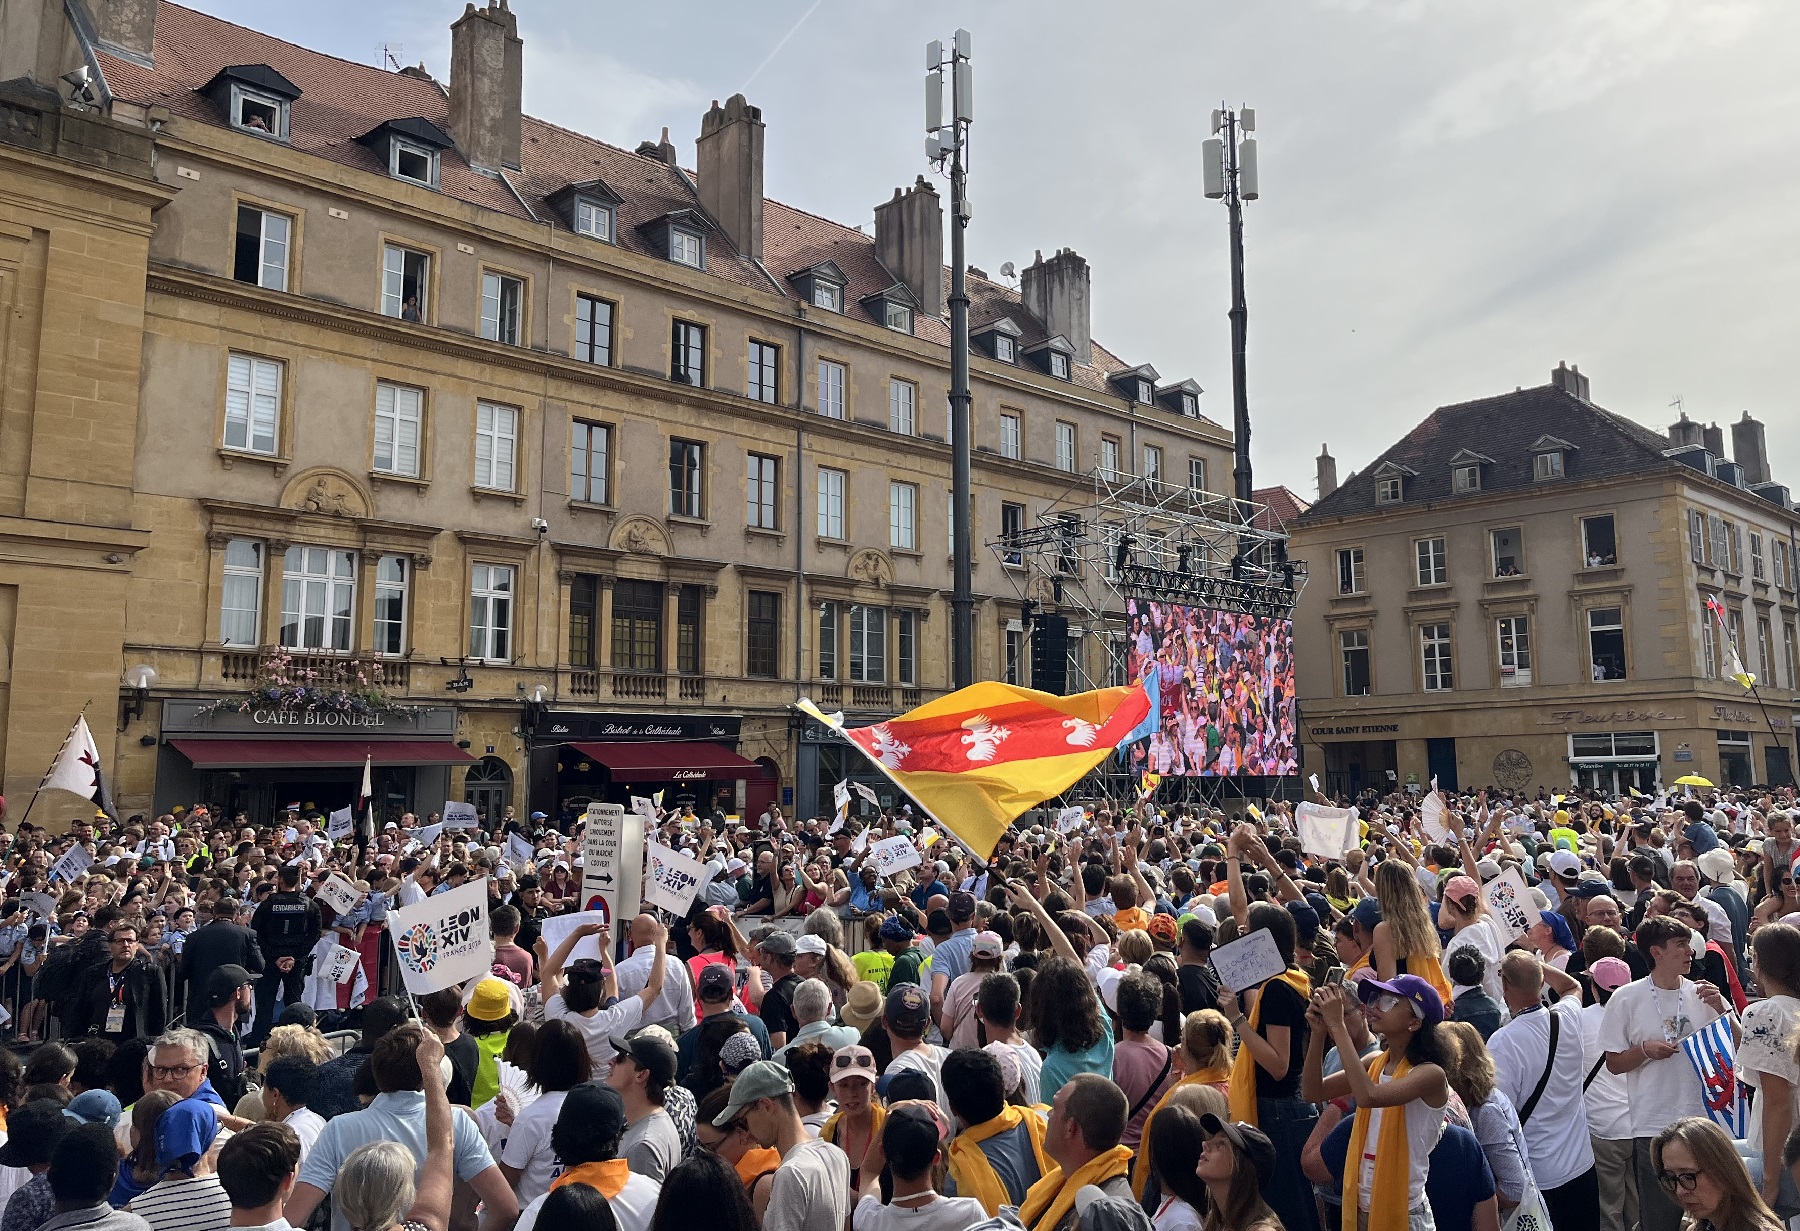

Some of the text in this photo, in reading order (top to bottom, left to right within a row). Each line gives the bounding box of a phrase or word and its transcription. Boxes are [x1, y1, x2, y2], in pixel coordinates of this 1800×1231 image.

[303, 711, 385, 726] BLONDEL
[601, 723, 633, 735] Bistrot
[644, 724, 682, 736] Cathédrale
[1312, 724, 1399, 735] COUR SAINT ETIENNE
[672, 770, 707, 779] La Cathédrale
[588, 808, 620, 817] STATIONNEMENT
[589, 828, 616, 837] UNIQUEMENT
[598, 839, 605, 847] LA
[891, 842, 910, 852] LEON
[588, 849, 596, 857] DU
[894, 848, 907, 857] XIV
[590, 859, 610, 868] COUVERT
[666, 867, 697, 887] LEON
[663, 876, 686, 891] XIV
[272, 903, 306, 912] GENDARMERIE
[440, 905, 480, 934] LEON
[1504, 909, 1521, 928] XIV
[1512, 904, 1532, 934] LEON
[441, 925, 470, 950] XIV
[442, 944, 467, 959] FRANCE
